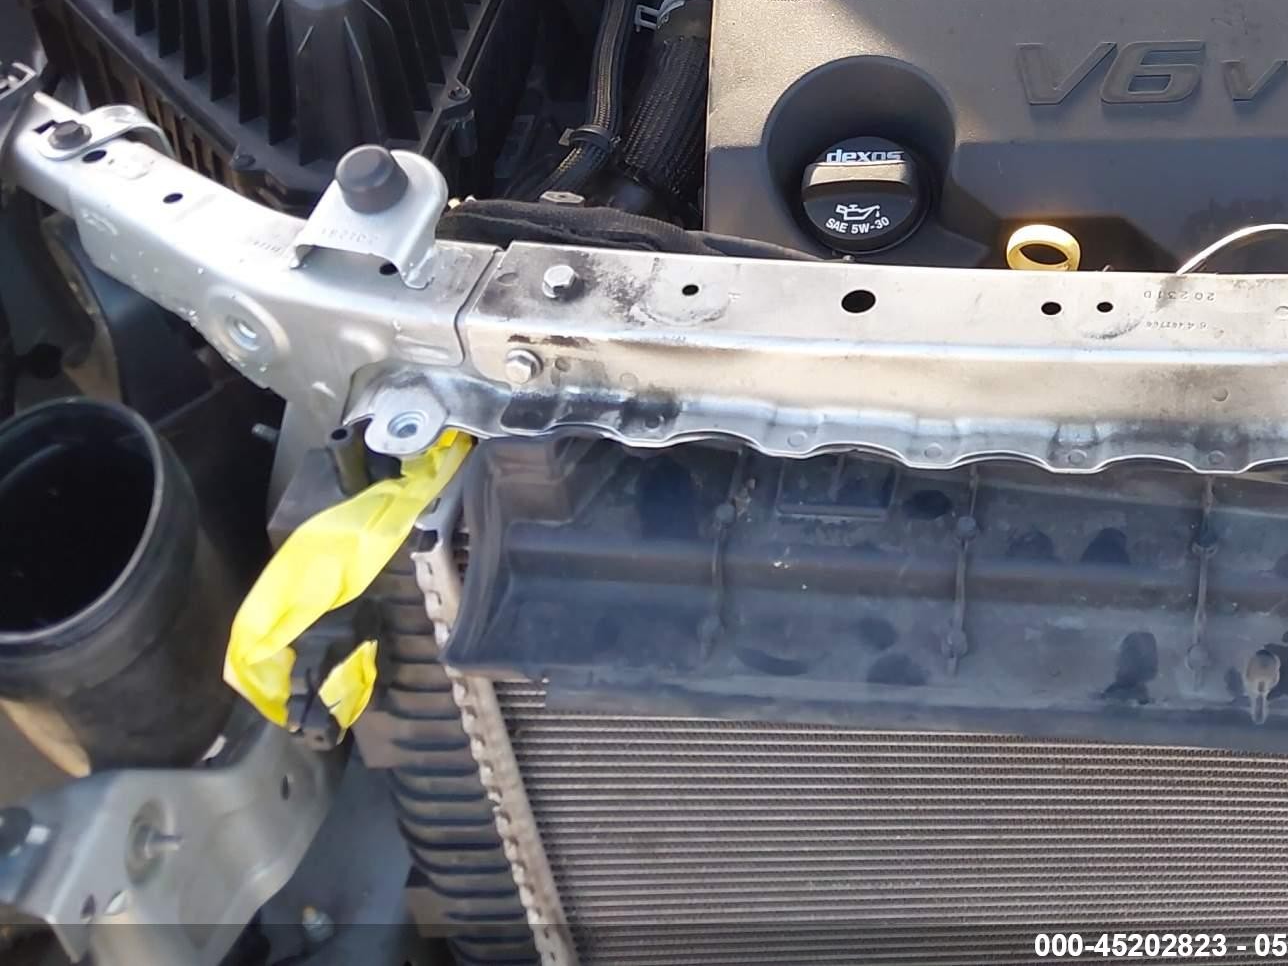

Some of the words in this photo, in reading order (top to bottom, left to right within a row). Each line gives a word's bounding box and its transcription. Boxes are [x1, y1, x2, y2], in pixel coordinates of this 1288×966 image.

[1016, 39, 1206, 105] V6
[826, 149, 905, 163] dexos
[825, 217, 849, 233] SAE
[850, 216, 890, 234] 5W-30
